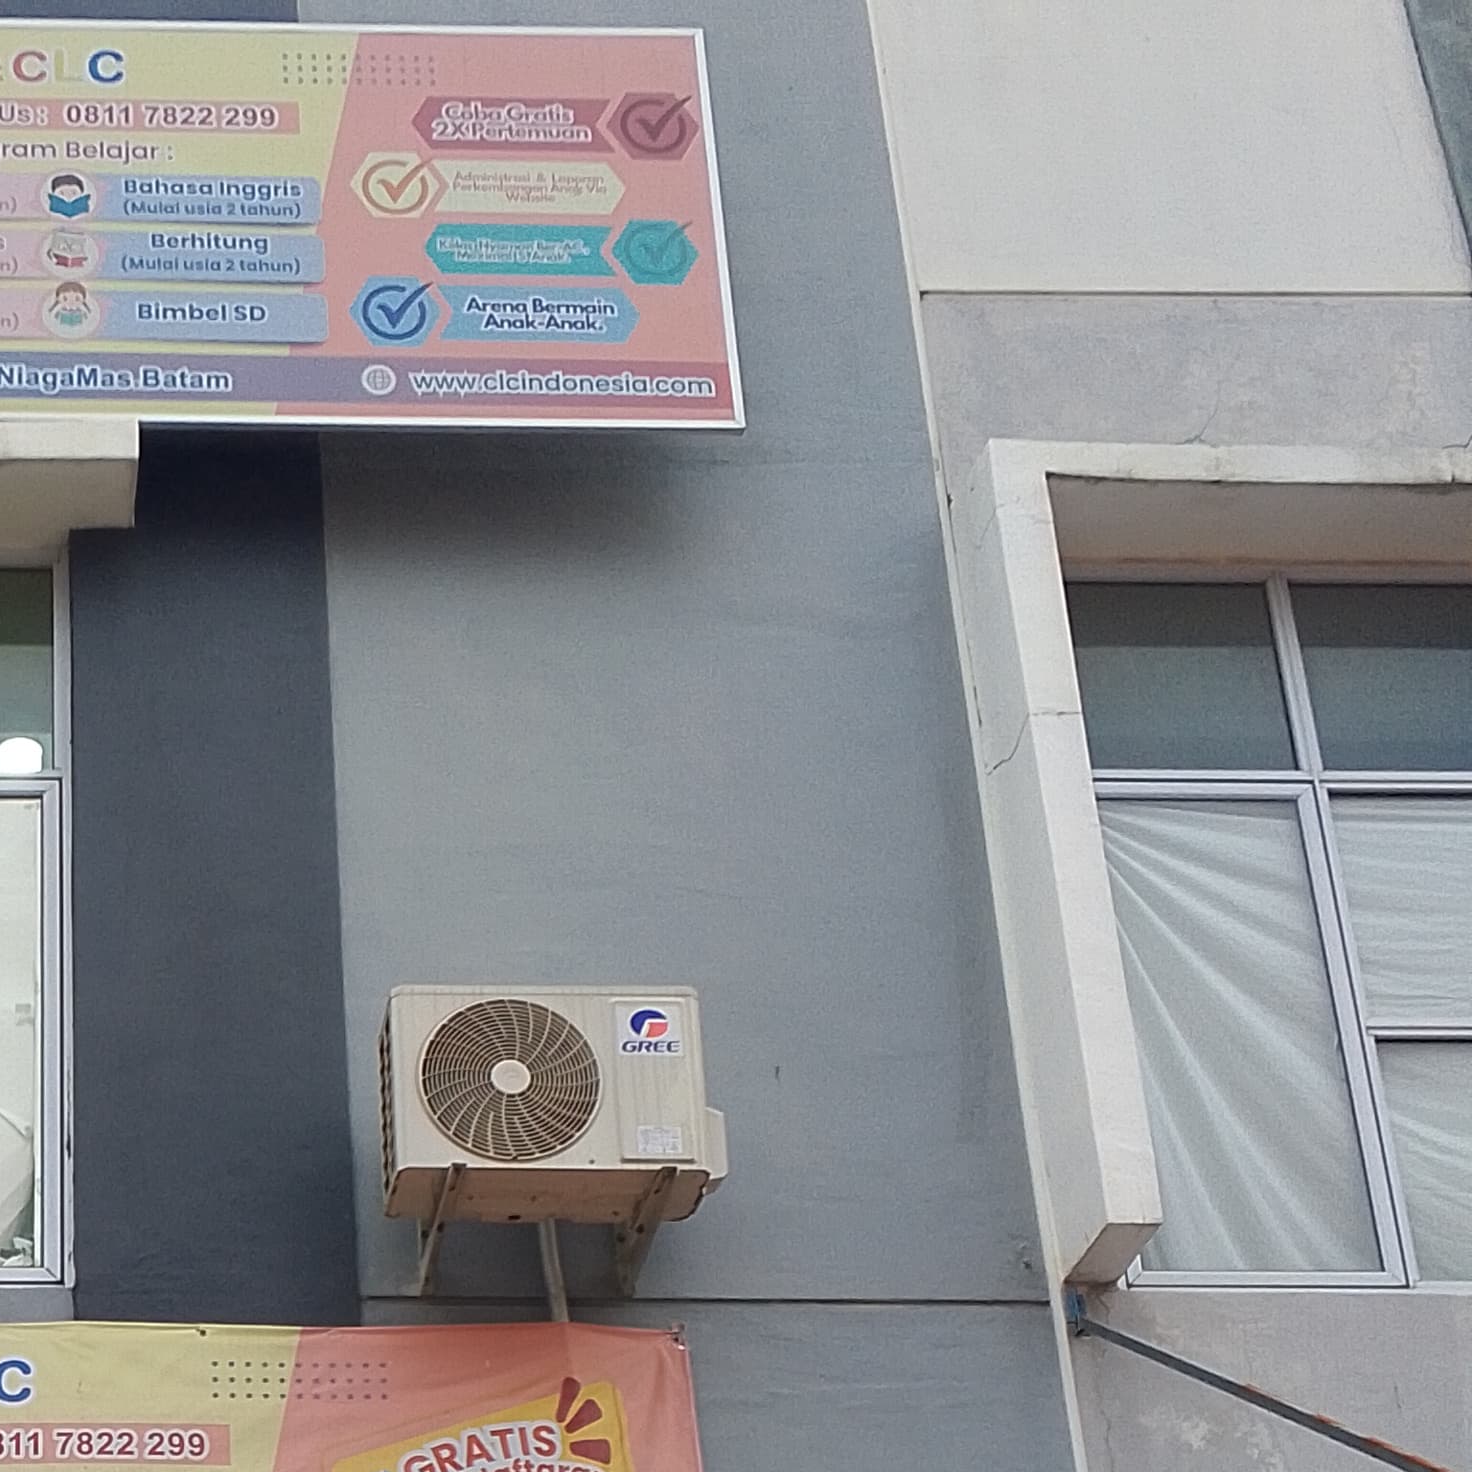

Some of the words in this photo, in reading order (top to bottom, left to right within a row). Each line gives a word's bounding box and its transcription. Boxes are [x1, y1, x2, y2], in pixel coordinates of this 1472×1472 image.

[12, 49, 124, 83] CLC
[66, 104, 132, 127] 0811
[144, 106, 214, 128] 7822
[223, 107, 278, 128] 299
[506, 106, 573, 123] Gratis
[472, 124, 591, 142] Pertemuan
[123, 179, 213, 195] Bahasa
[219, 181, 302, 201] Inggris
[123, 200, 180, 216] (Mulai
[184, 202, 222, 216] usia
[227, 203, 237, 216] 2
[240, 203, 302, 219] tahun)
[150, 232, 269, 255] Berhitung
[121, 255, 179, 273] (Mulai
[183, 257, 222, 272] usia
[226, 259, 236, 272] 2
[239, 258, 301, 275] tahun)
[137, 303, 227, 322] Bimbel
[233, 306, 267, 322] SD
[466, 299, 528, 315] Arena
[533, 300, 616, 317] Bermain
[411, 372, 715, 396] www.clcindonesia.com
[621, 1040, 681, 1054] GREE
[54, 1432, 136, 1457] 7822
[146, 1432, 207, 1458] 299
